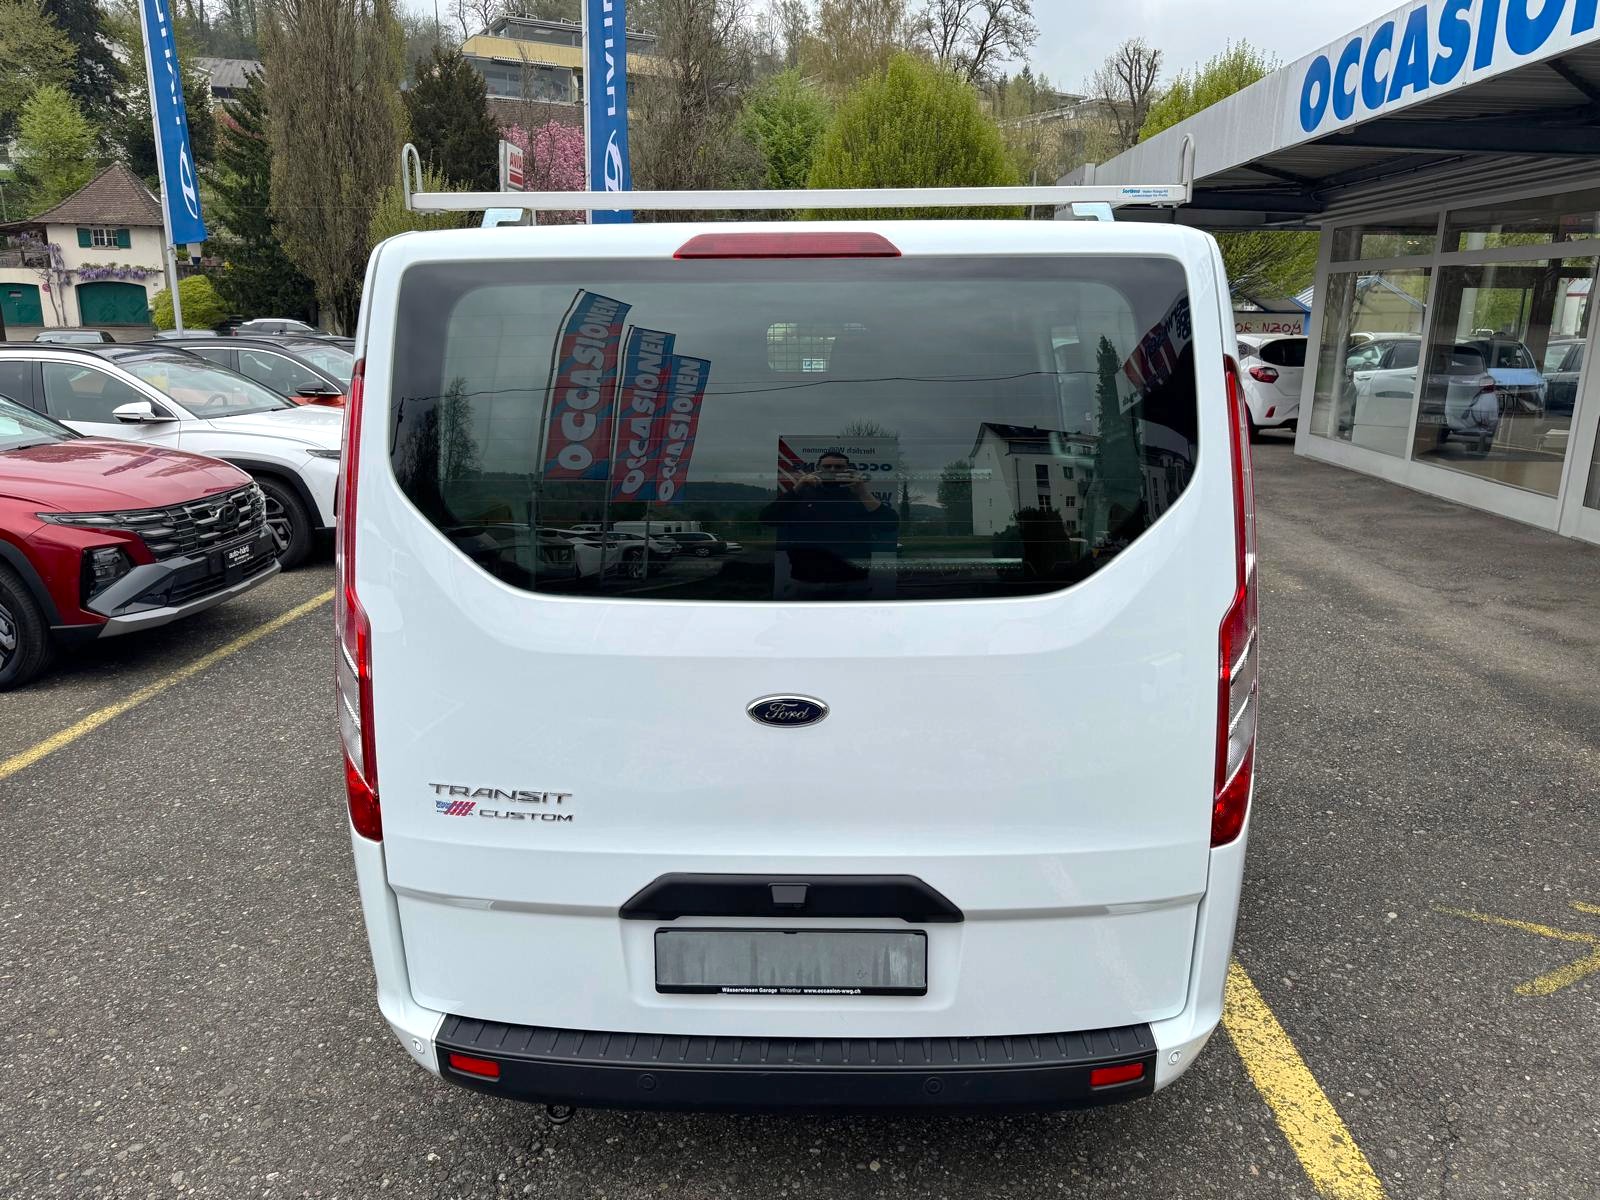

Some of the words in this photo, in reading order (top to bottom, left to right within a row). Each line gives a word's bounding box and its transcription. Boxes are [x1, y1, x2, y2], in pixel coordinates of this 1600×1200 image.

[558, 297, 620, 471] OCCASIONEN
[621, 329, 665, 494] OCCASIONEN
[659, 358, 701, 502] OCCASIONEN
[765, 702, 810, 720] Ford
[428, 783, 573, 804] TRANSIT
[479, 809, 575, 822] CUSTOM
[758, 987, 778, 995] Garage
